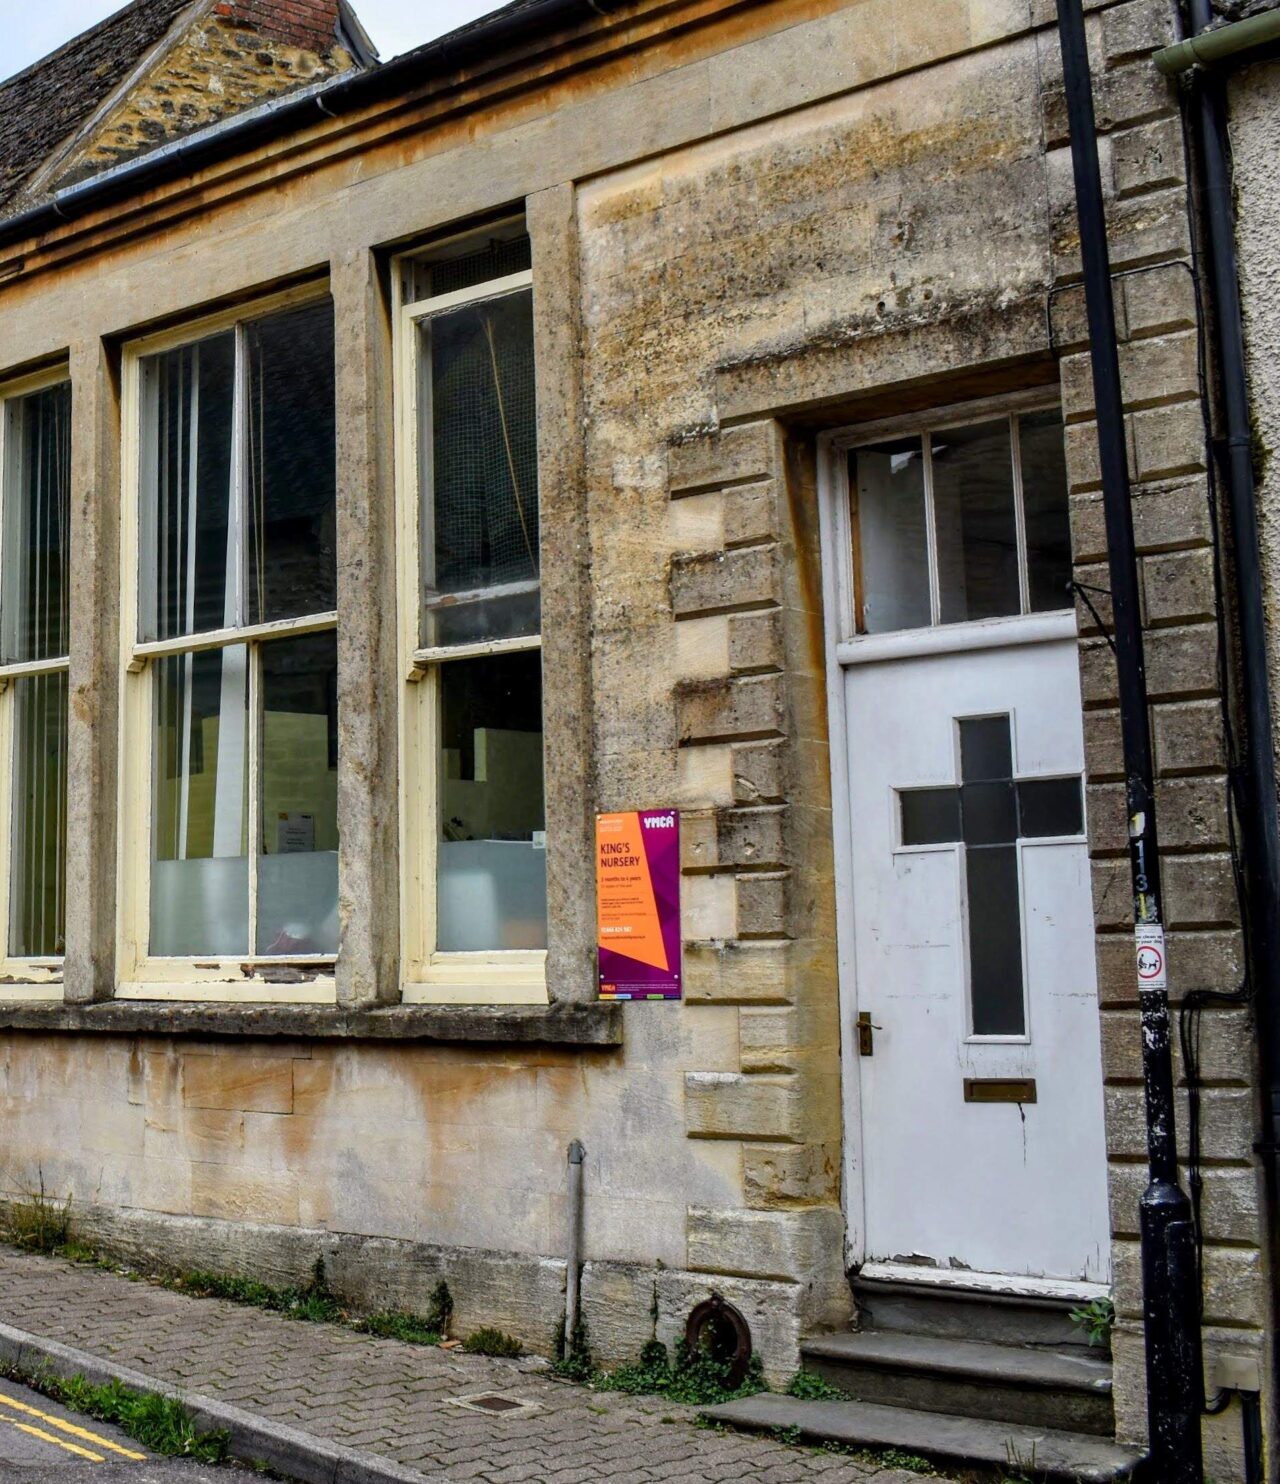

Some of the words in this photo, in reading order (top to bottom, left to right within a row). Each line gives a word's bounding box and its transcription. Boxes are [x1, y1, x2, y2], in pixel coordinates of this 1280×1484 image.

[644, 816, 674, 829] YMCA
[601, 843, 630, 854] KING'S
[601, 856, 640, 867] NURSERY
